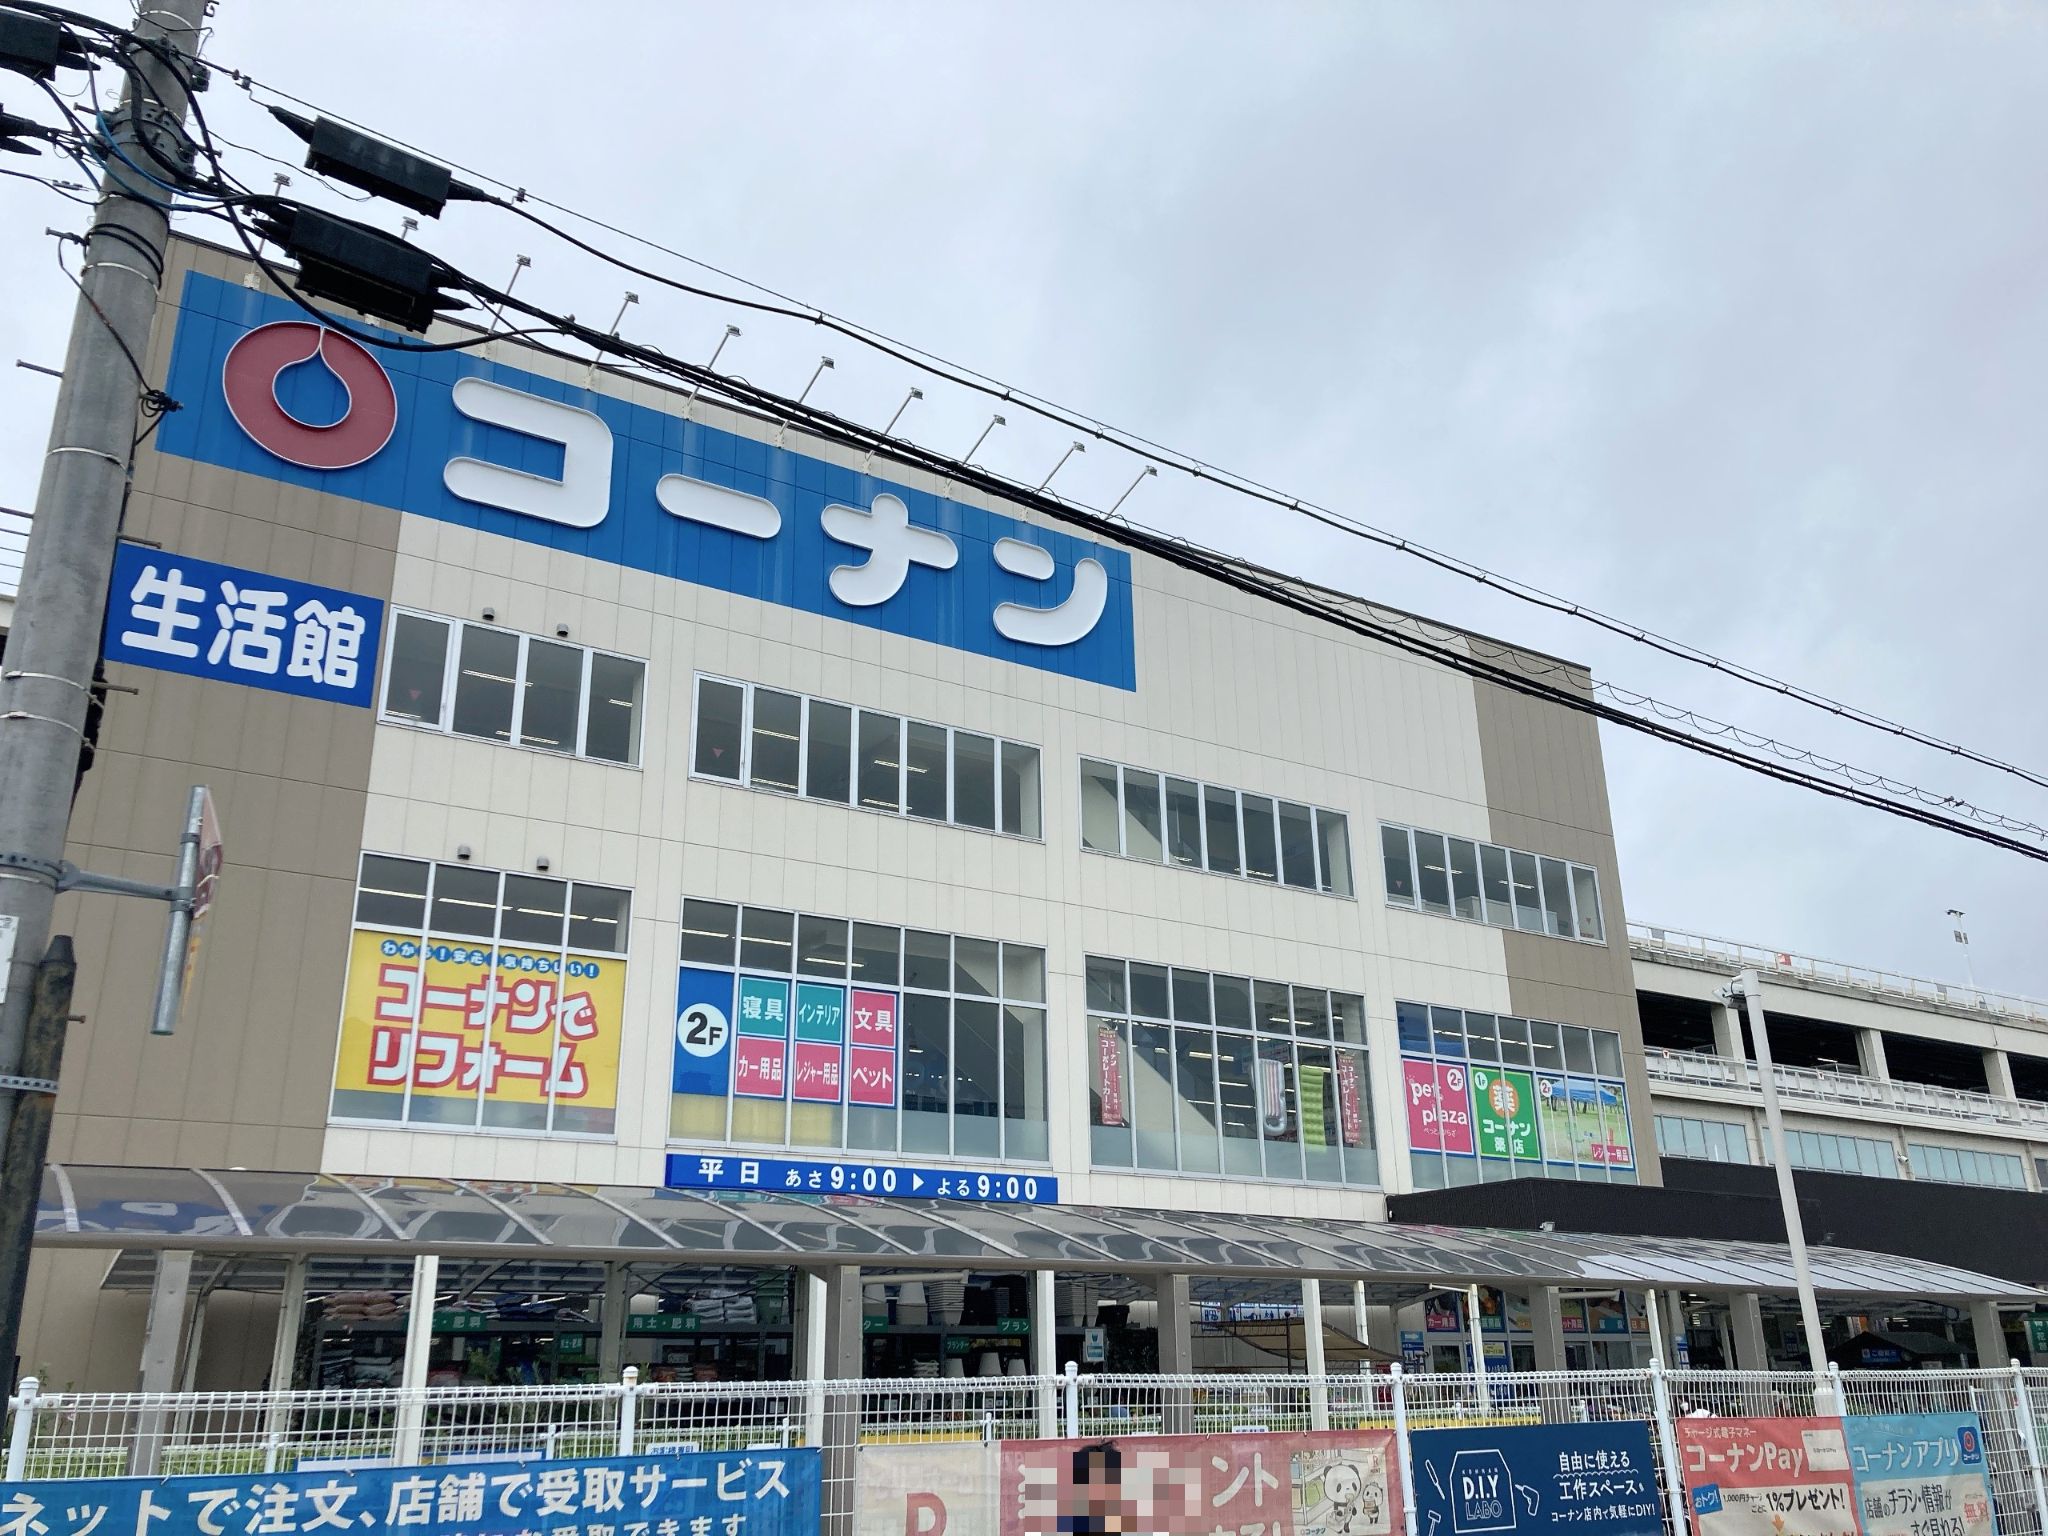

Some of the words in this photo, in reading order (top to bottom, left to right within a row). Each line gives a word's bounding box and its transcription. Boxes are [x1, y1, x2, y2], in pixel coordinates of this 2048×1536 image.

[443, 376, 1108, 646] コーナン
[121, 564, 366, 690] 生活館
[378, 965, 597, 1038] コーナンで
[743, 995, 784, 1022] 寝具
[798, 1002, 841, 1026] インテリア
[686, 1011, 722, 1045] 2F
[854, 1008, 893, 1033] 文具
[370, 1027, 586, 1096] リフォーム
[738, 1056, 782, 1081] カー用品
[797, 1059, 839, 1086] レジャー用品
[852, 1065, 893, 1089] ペット
[1450, 1072, 1462, 1087] 2F
[1422, 1107, 1468, 1125] plaza
[1482, 1119, 1531, 1137] コーナン
[699, 1158, 759, 1185] 平日
[1684, 1426, 1758, 1439] チャージ式電子マネー
[1558, 1450, 1630, 1472] 自由に使える
[1686, 1441, 1803, 1478] コーナンPay
[1853, 1436, 1960, 1473] コーナンアプリ
[0, 1458, 791, 1536] ネットで注文、店舗で受取サービス
[1462, 1474, 1499, 1500] D.I.Y
[1559, 1479, 1638, 1501] 工作スペース
[1695, 1489, 1721, 1509] おトク!
[1465, 1500, 1503, 1520] LABO
[1551, 1503, 1656, 1522] コーナン店内で気軽にDIY!
[1766, 1488, 1846, 1513] 1%プレゼント!
